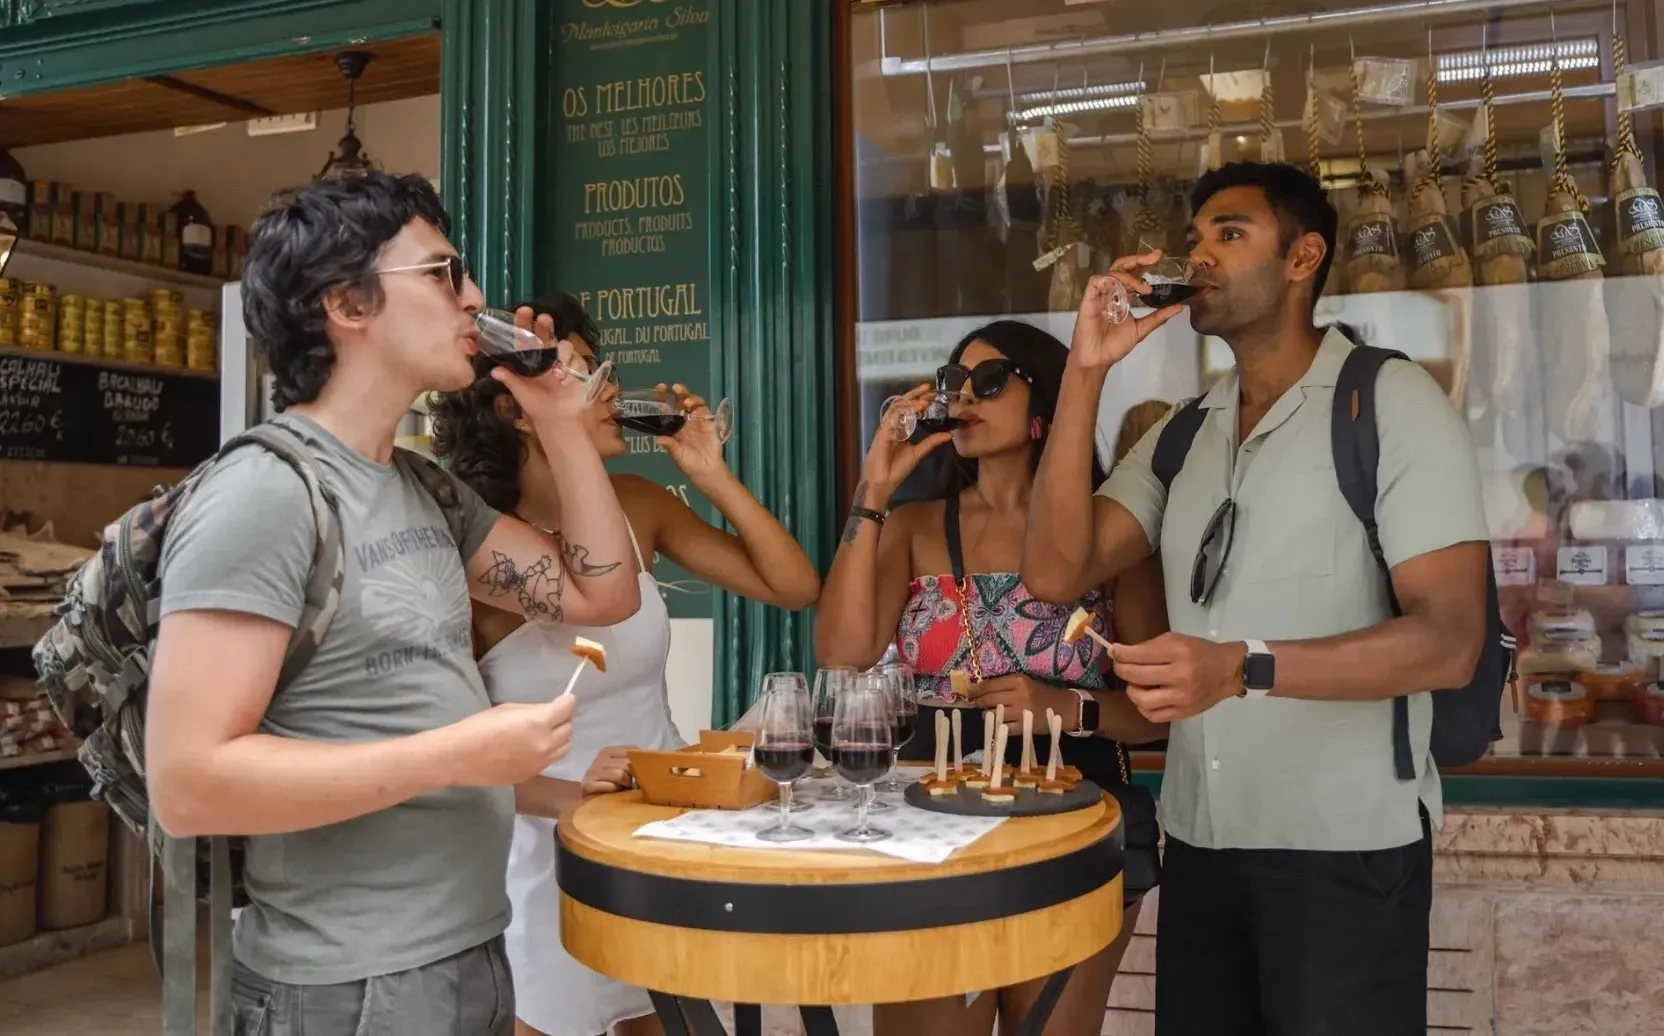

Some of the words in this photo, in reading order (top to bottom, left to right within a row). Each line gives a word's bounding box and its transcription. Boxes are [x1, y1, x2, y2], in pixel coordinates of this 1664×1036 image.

[563, 86, 588, 118] OS
[595, 71, 706, 115] MELHORES
[584, 174, 684, 214] PRODUTOS
[638, 212, 693, 232] PRODUITS
[602, 236, 665, 256] PRODUCTOS
[597, 283, 701, 321] PORTUGAL
[636, 325, 651, 343] DU
[653, 322, 710, 342] PORTUGAL
[617, 349, 662, 363] PORTUGAL
